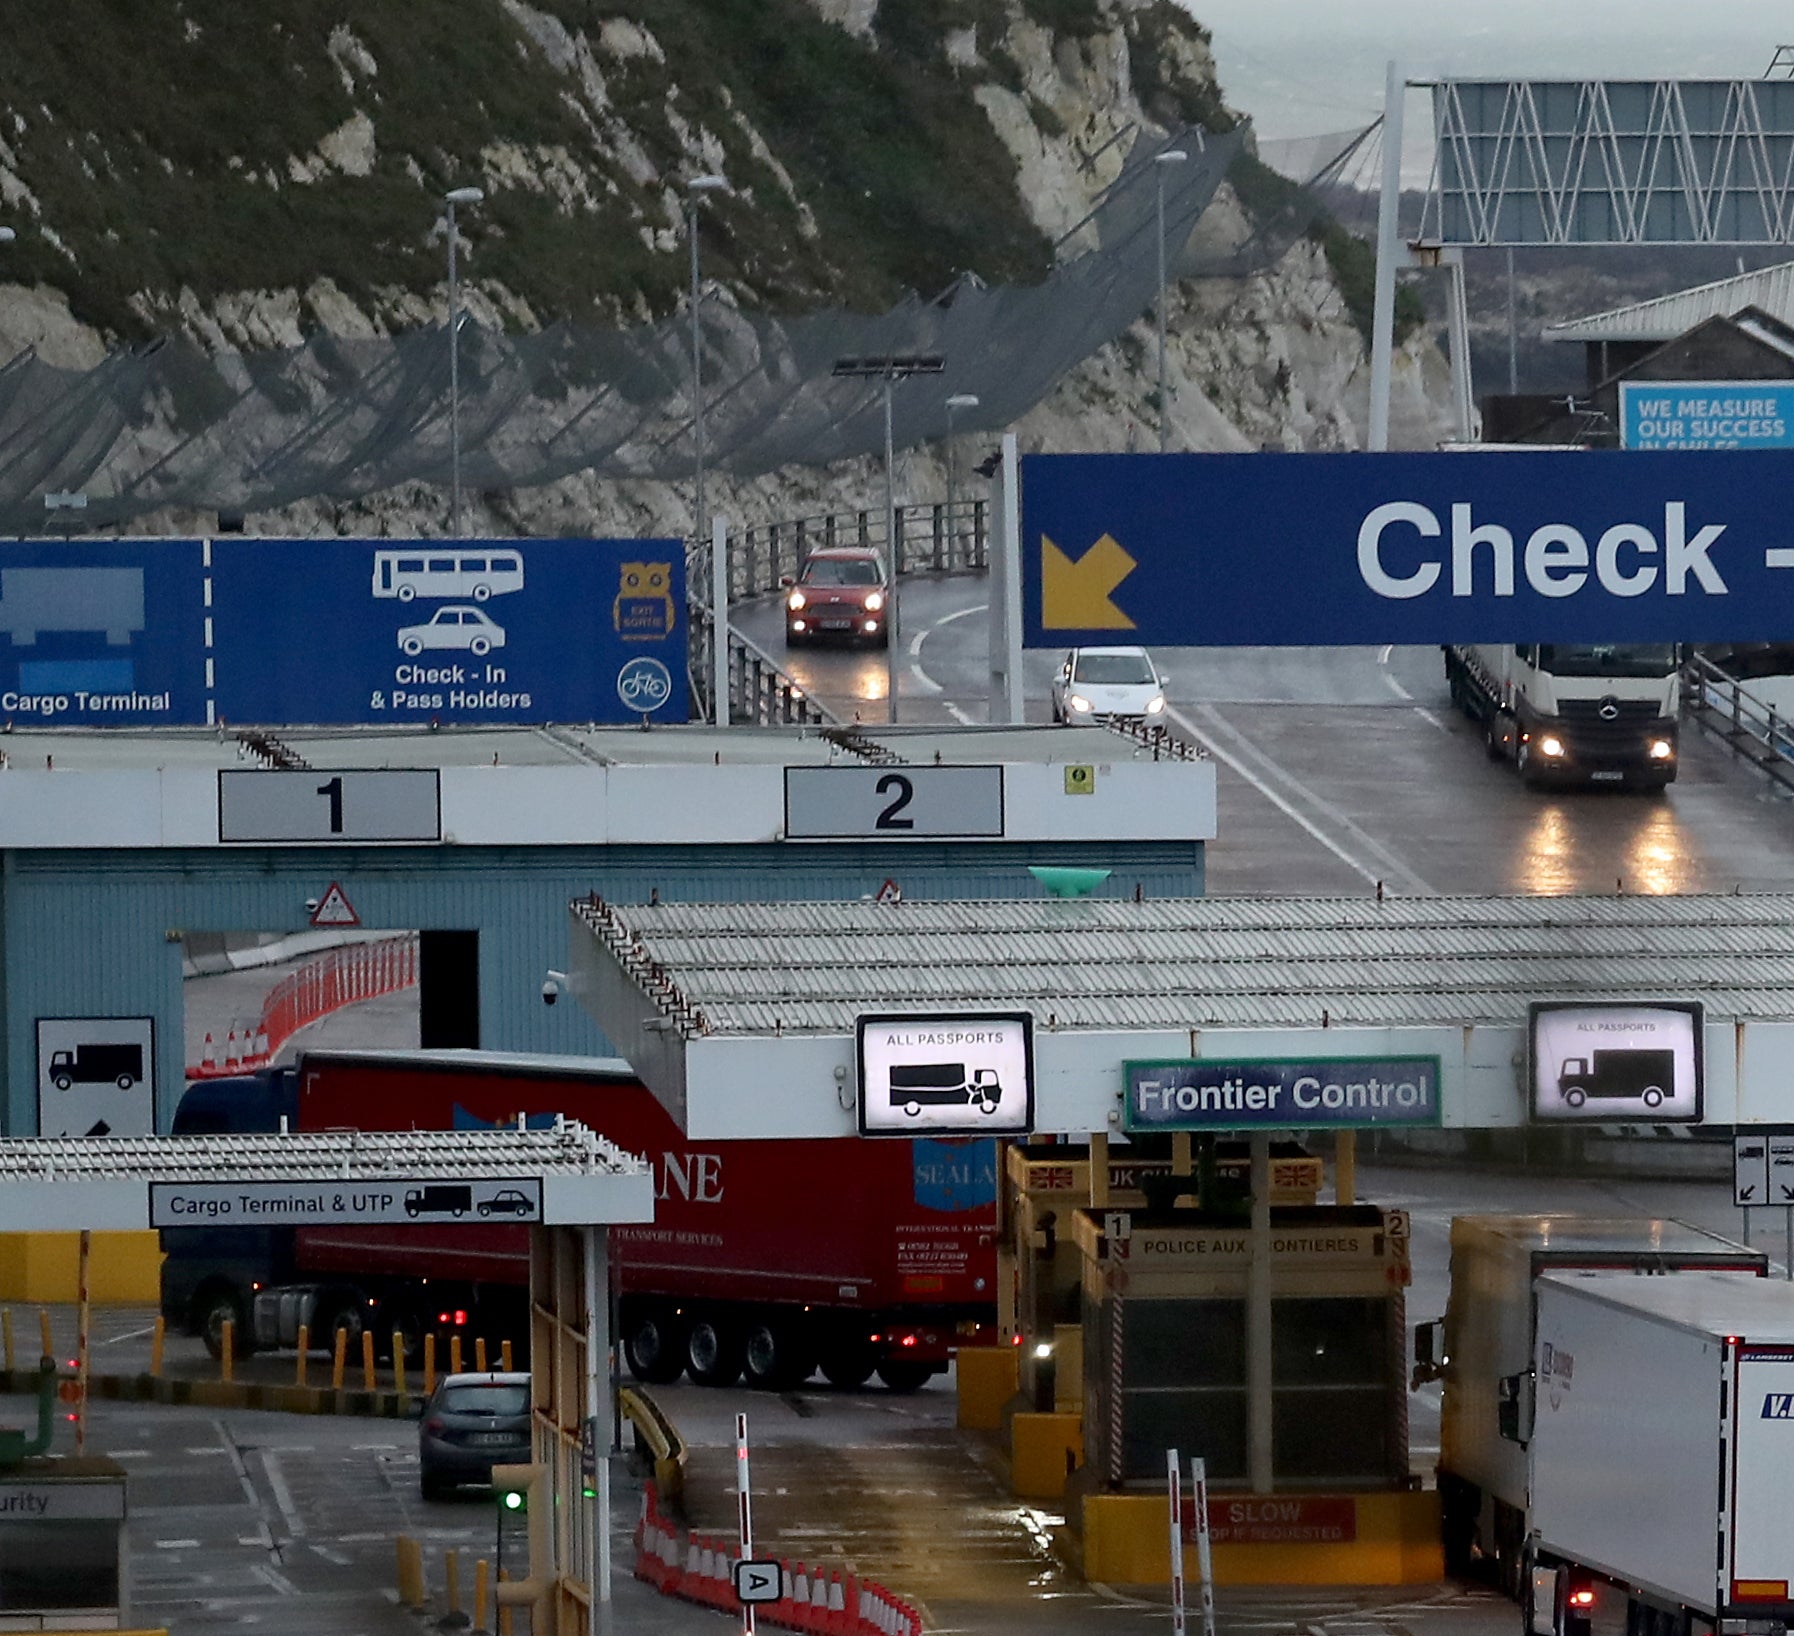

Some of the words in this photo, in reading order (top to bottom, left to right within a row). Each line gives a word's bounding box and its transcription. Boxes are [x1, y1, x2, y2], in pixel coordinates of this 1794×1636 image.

[1638, 399, 1672, 417] WE
[1677, 399, 1778, 417] MEASURE
[1637, 420, 1685, 438] OUR
[1690, 419, 1786, 438] SUCCESS
[1357, 501, 1730, 599] Check
[396, 664, 464, 685] Check
[486, 664, 506, 684] In
[1, 691, 67, 715] Cargo
[74, 690, 171, 712] Terminal
[370, 689, 387, 708] &
[392, 689, 444, 709] Pass
[448, 688, 532, 709] Holders
[316, 776, 343, 833] 1
[875, 774, 915, 830] 2
[1577, 1022, 1595, 1032] ALL
[1597, 1022, 1657, 1032] PASSPORTS
[886, 1033, 914, 1046] ALL
[918, 1032, 1005, 1045] PASSPORTS
[1138, 1079, 1282, 1112] Frontier
[1292, 1075, 1428, 1110] Control
[170, 1196, 232, 1218] Cargo
[238, 1193, 324, 1213] Terminal
[333, 1195, 347, 1212] &
[352, 1194, 394, 1212] UTP
[1112, 1216, 1122, 1236] 1
[1388, 1215, 1402, 1236] 2
[1143, 1238, 1206, 1254] POLICE
[1211, 1237, 1245, 1254] AUX
[1252, 1237, 1360, 1253] ONTIERES
[1230, 1503, 1300, 1523] SLOW
[748, 1573, 769, 1591] A
